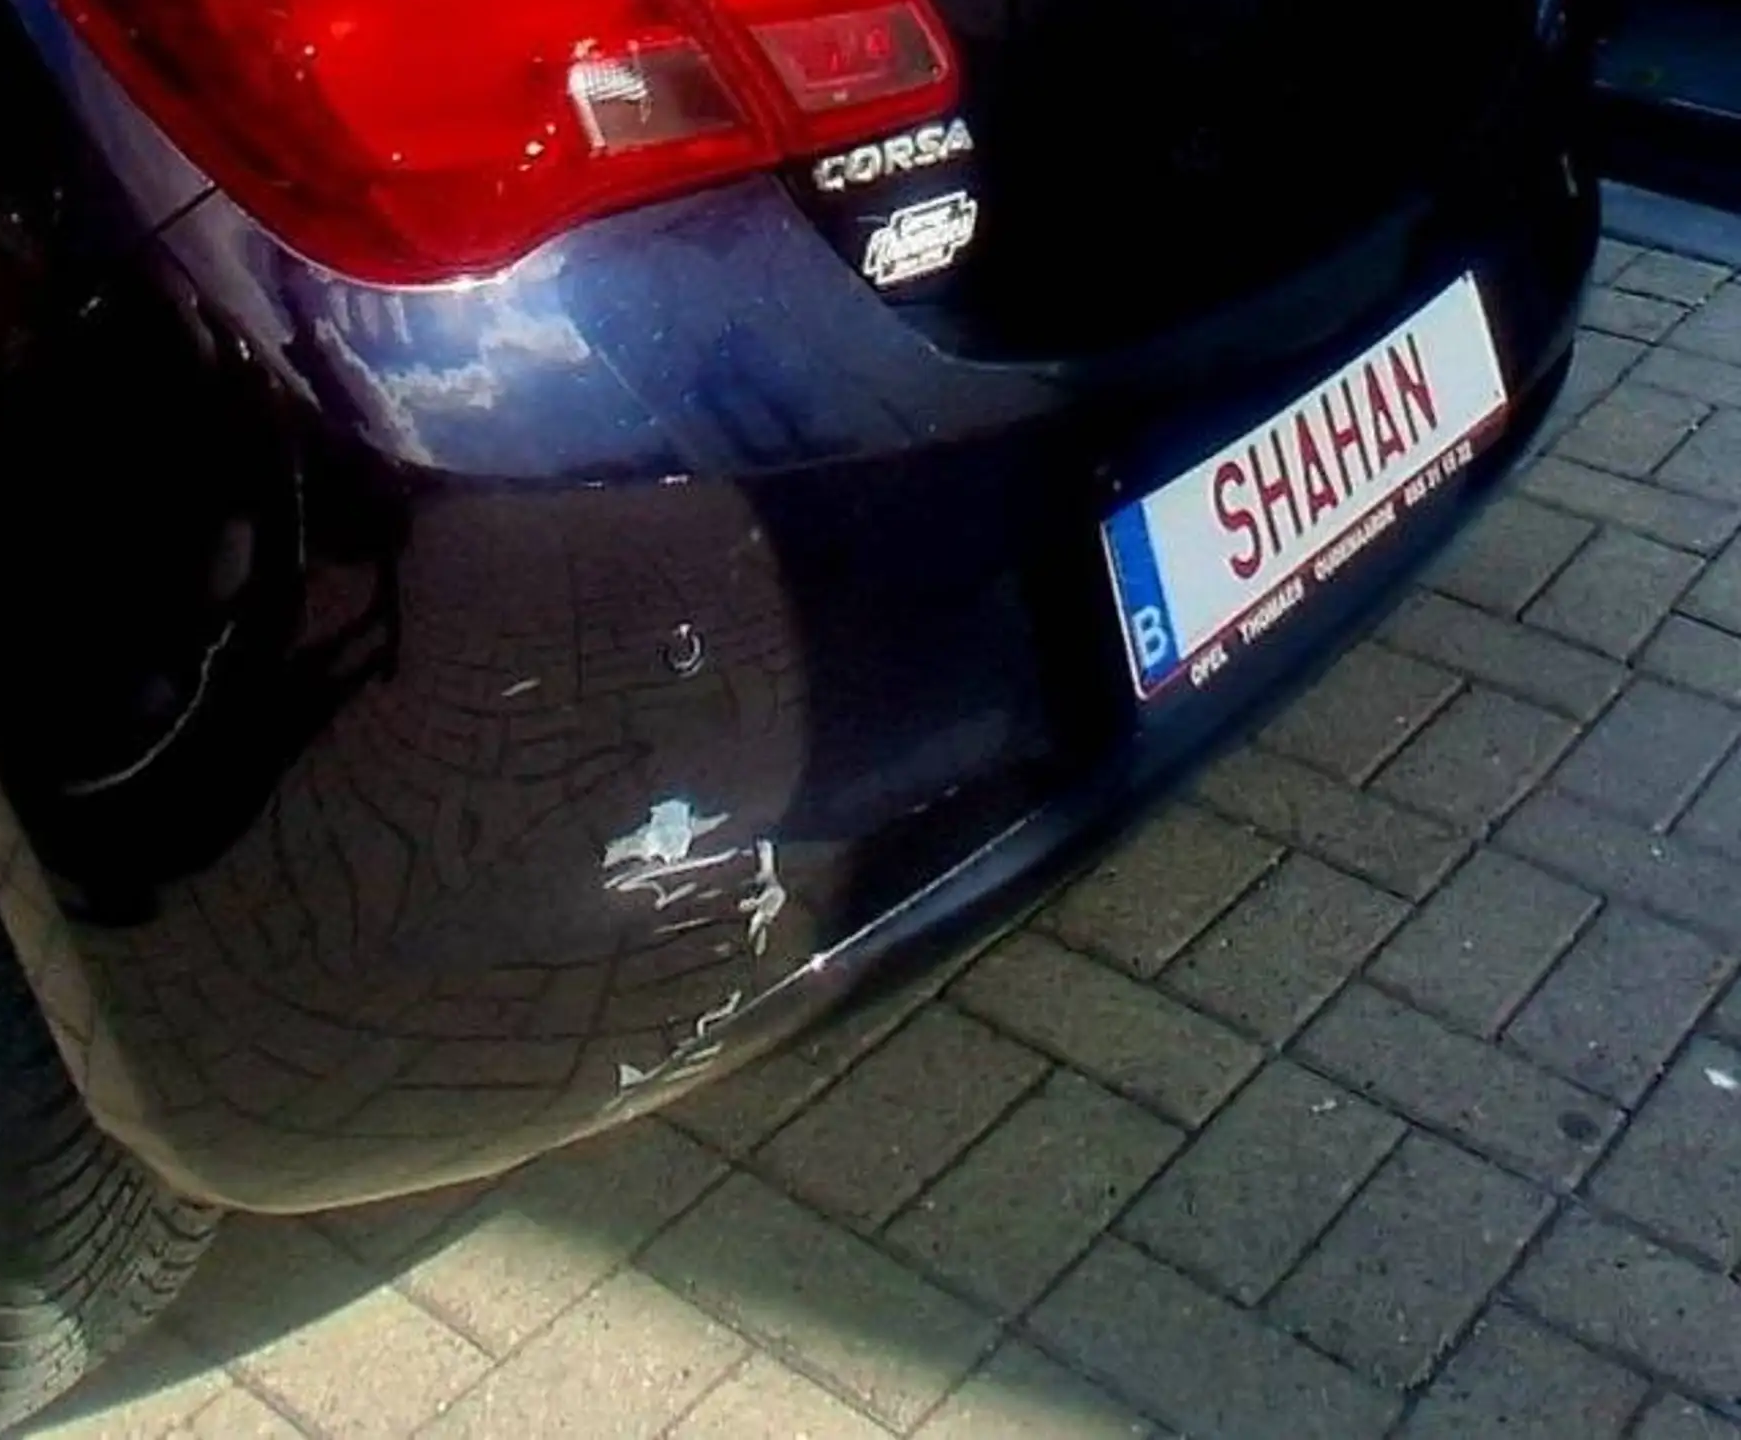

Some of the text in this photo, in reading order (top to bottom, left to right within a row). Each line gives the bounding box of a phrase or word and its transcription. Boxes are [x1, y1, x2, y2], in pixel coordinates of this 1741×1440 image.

[813, 116, 975, 193] CORSA
[1213, 333, 1438, 579] SHAHAN
[1130, 604, 1169, 668] B
[1189, 641, 1229, 687] OPEL
